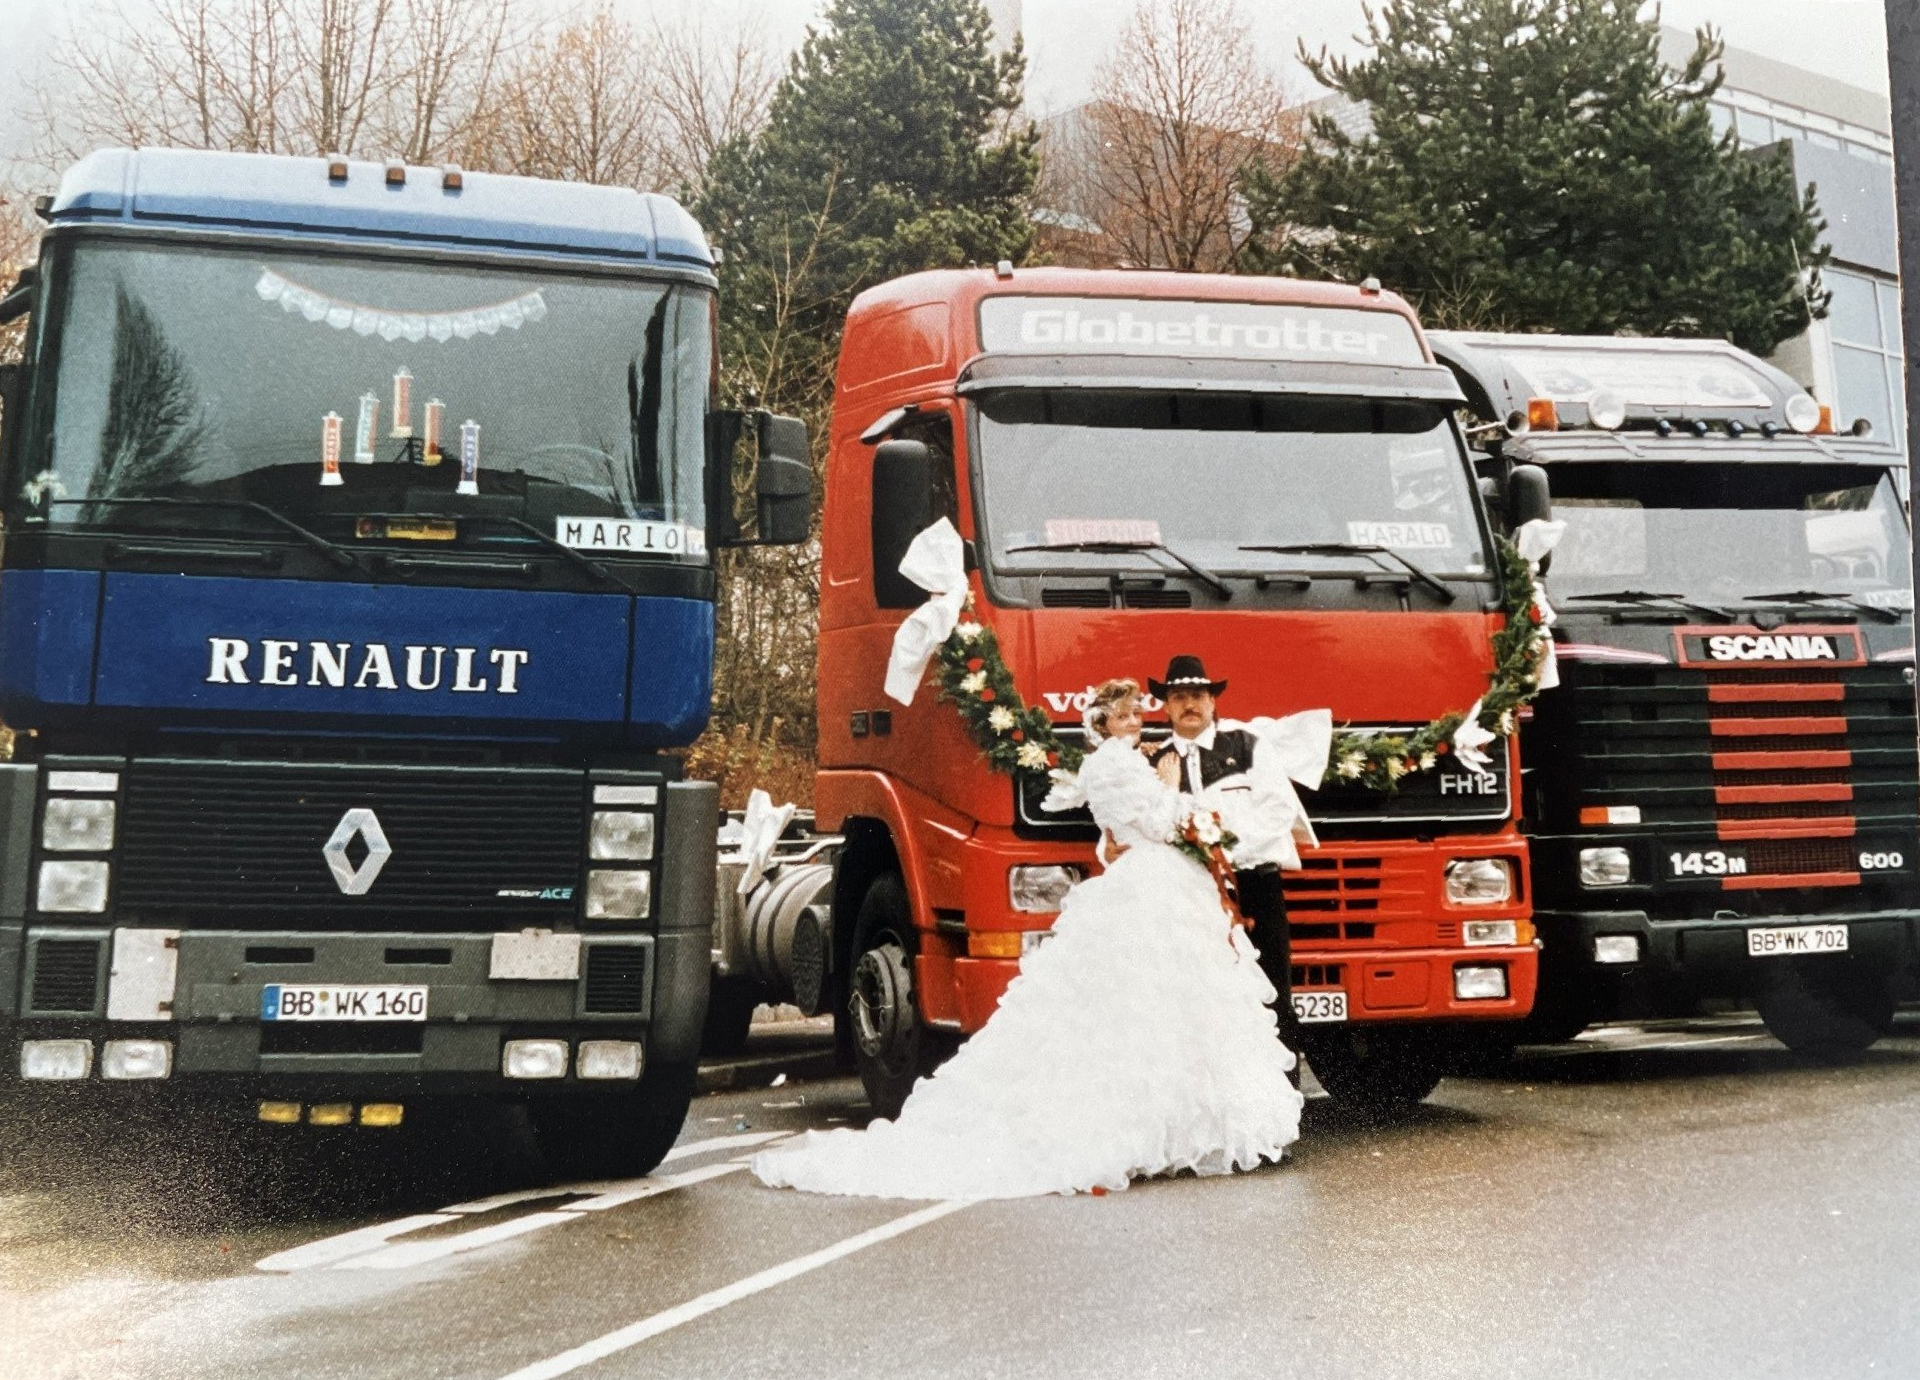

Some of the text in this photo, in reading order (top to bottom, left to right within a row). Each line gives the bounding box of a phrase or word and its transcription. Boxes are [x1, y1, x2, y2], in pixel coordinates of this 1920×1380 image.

[1020, 309, 1388, 356] Globetrotter
[566, 522, 678, 549] MARIO
[1354, 525, 1446, 546] HARALD
[1709, 635, 1836, 661] SCANIA
[206, 638, 528, 693] RENAULT
[1043, 692, 1165, 712] VOO
[1441, 772, 1497, 795] FH12
[1859, 852, 1903, 869] 600
[1752, 930, 1845, 951] BB WK 702
[281, 992, 423, 1016] BB WK 160
